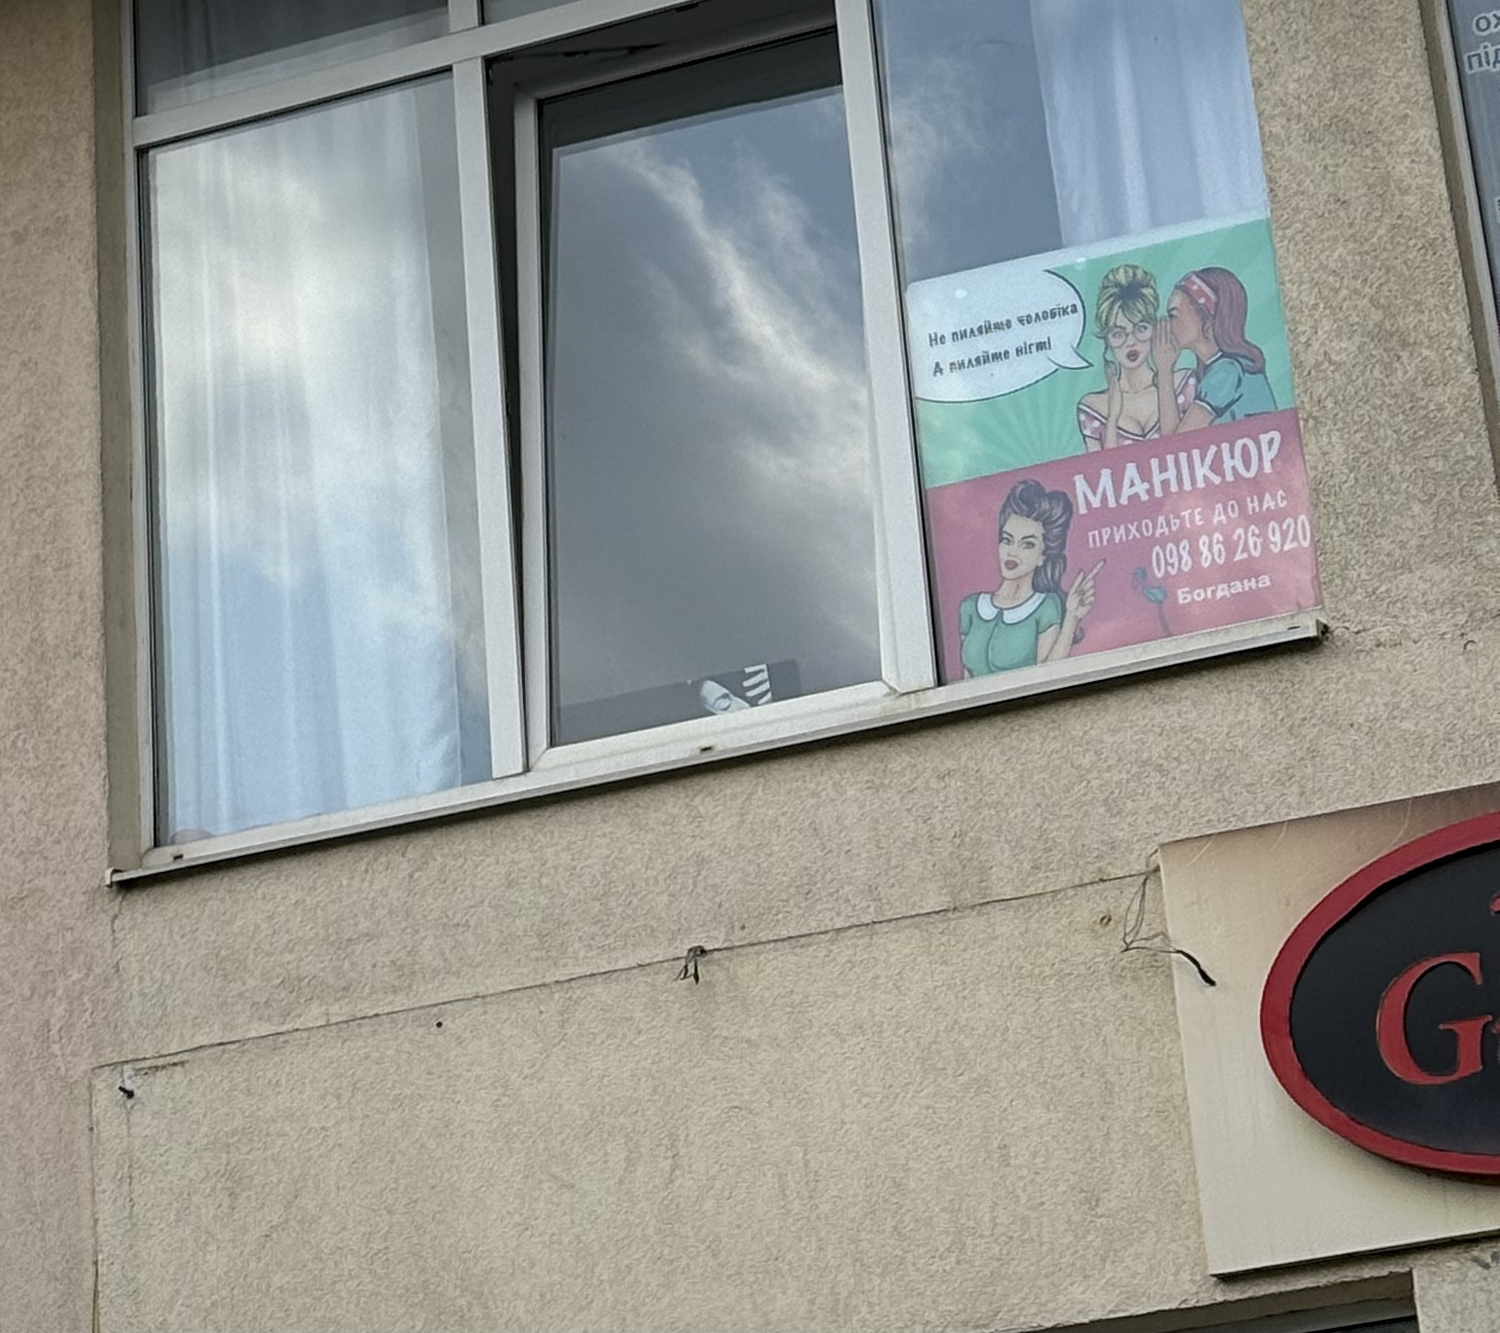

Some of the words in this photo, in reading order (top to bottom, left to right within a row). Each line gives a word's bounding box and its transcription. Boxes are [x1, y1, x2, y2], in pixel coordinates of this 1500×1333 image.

[932, 361, 944, 377] А
[1072, 429, 1282, 515] МАНІКЮР
[1087, 507, 1205, 549] ПРИХОДЬТЕ
[1212, 500, 1240, 526] ДО
[1246, 489, 1288, 516] НАС
[1151, 538, 1193, 579] 098
[1198, 532, 1226, 569] 86
[1232, 524, 1263, 563] 26
[1267, 513, 1311, 554] 920
[1176, 573, 1272, 605] Богдана
